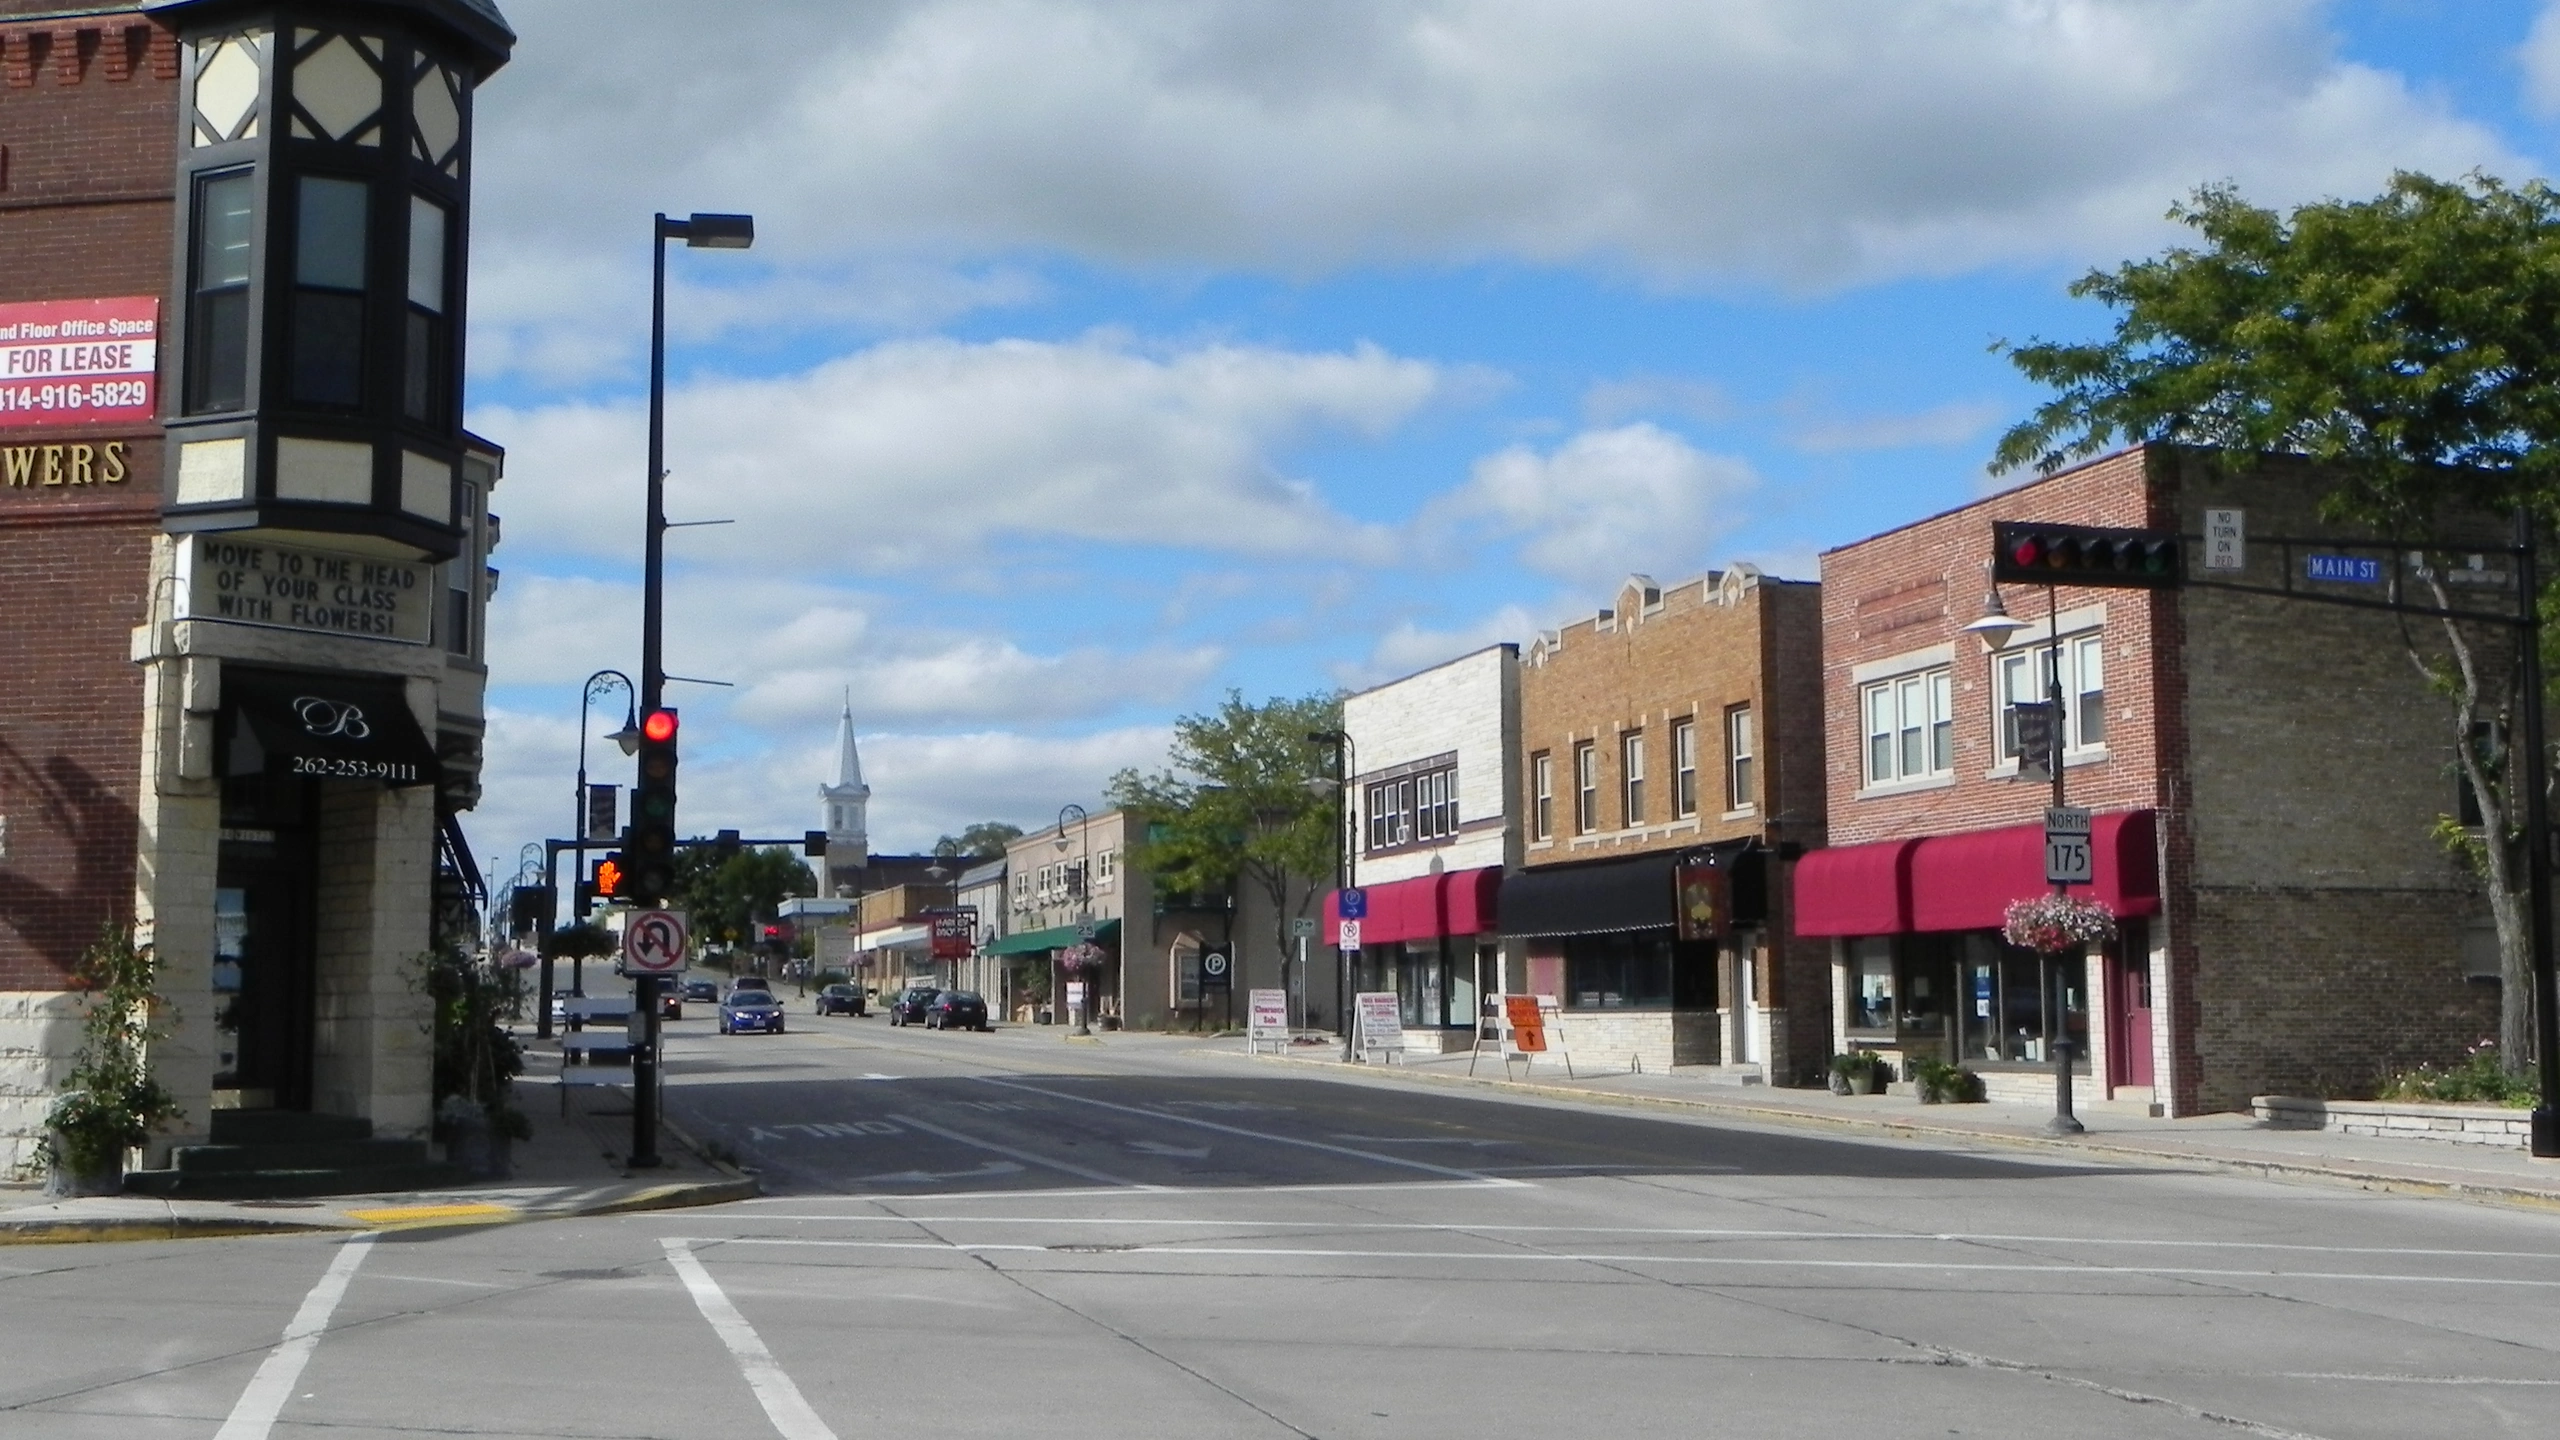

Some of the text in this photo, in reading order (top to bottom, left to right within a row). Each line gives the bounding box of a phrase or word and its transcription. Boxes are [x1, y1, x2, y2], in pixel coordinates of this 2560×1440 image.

[21, 321, 58, 339] Floor
[61, 319, 105, 338] Office
[108, 317, 153, 337] Space
[8, 345, 132, 374] FOR LEASE
[3, 441, 125, 486] WERS
[2218, 511, 2231, 524] NO
[2213, 526, 2236, 538] TURN
[2217, 540, 2230, 552] ON
[203, 541, 415, 589] MOVE TO THE HEAD
[2214, 555, 2233, 568] RED
[2312, 558, 2376, 578] MAIN ST
[217, 570, 396, 611] OF YOUR CLASS
[218, 595, 394, 634] WITH FLOWERS!
[293, 756, 417, 780] 262-253-9111
[2047, 812, 2089, 829] NORTH
[2053, 844, 2085, 872] 175
[1077, 925, 1094, 937] 25
